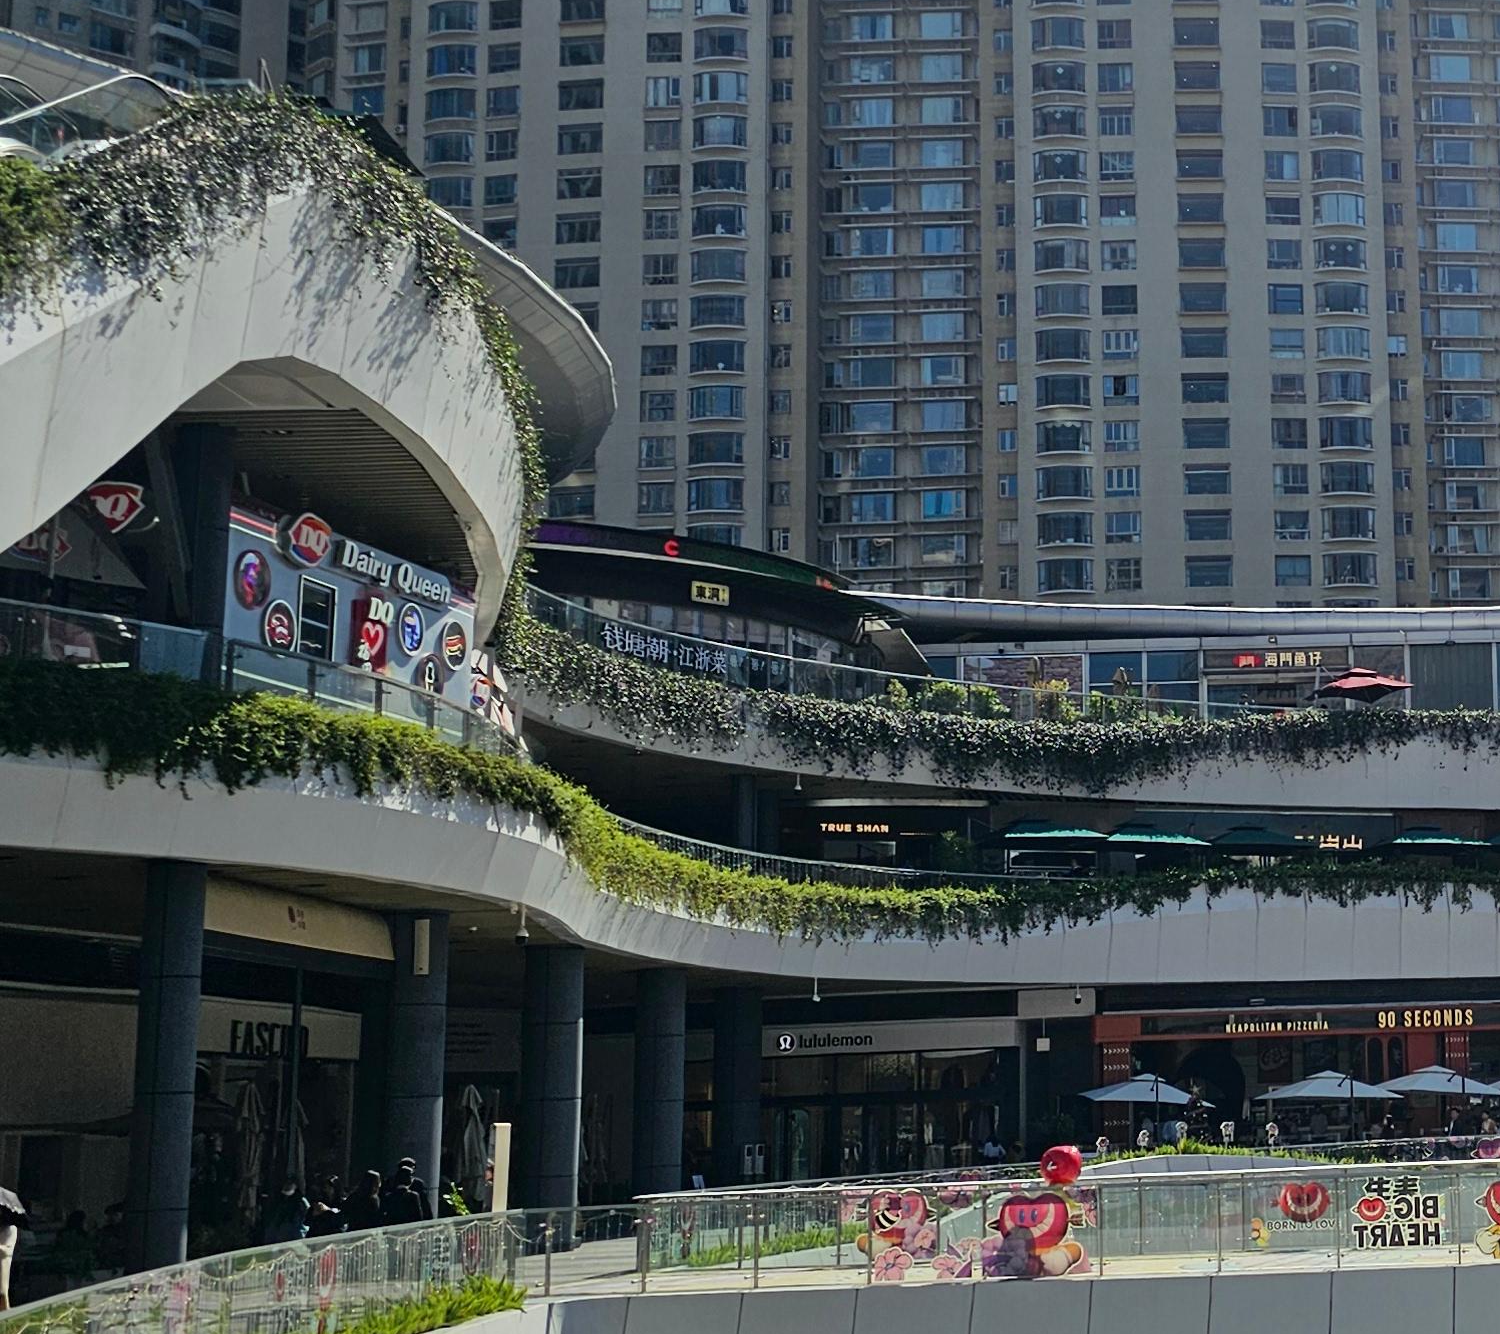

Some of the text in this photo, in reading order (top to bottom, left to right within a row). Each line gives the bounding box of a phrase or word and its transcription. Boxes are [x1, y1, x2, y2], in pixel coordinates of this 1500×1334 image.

[300, 524, 328, 556] DQ
[342, 539, 452, 604] Dairy Queen
[368, 596, 395, 626] DQ
[820, 823, 889, 834] TRUE SHAN
[1225, 1020, 1329, 1034] NEAPOLITAN PIZZERIA
[1378, 1008, 1474, 1029] 90 SECONDS
[799, 1033, 873, 1049] lululemon
[1267, 1220, 1297, 1231] BORN
